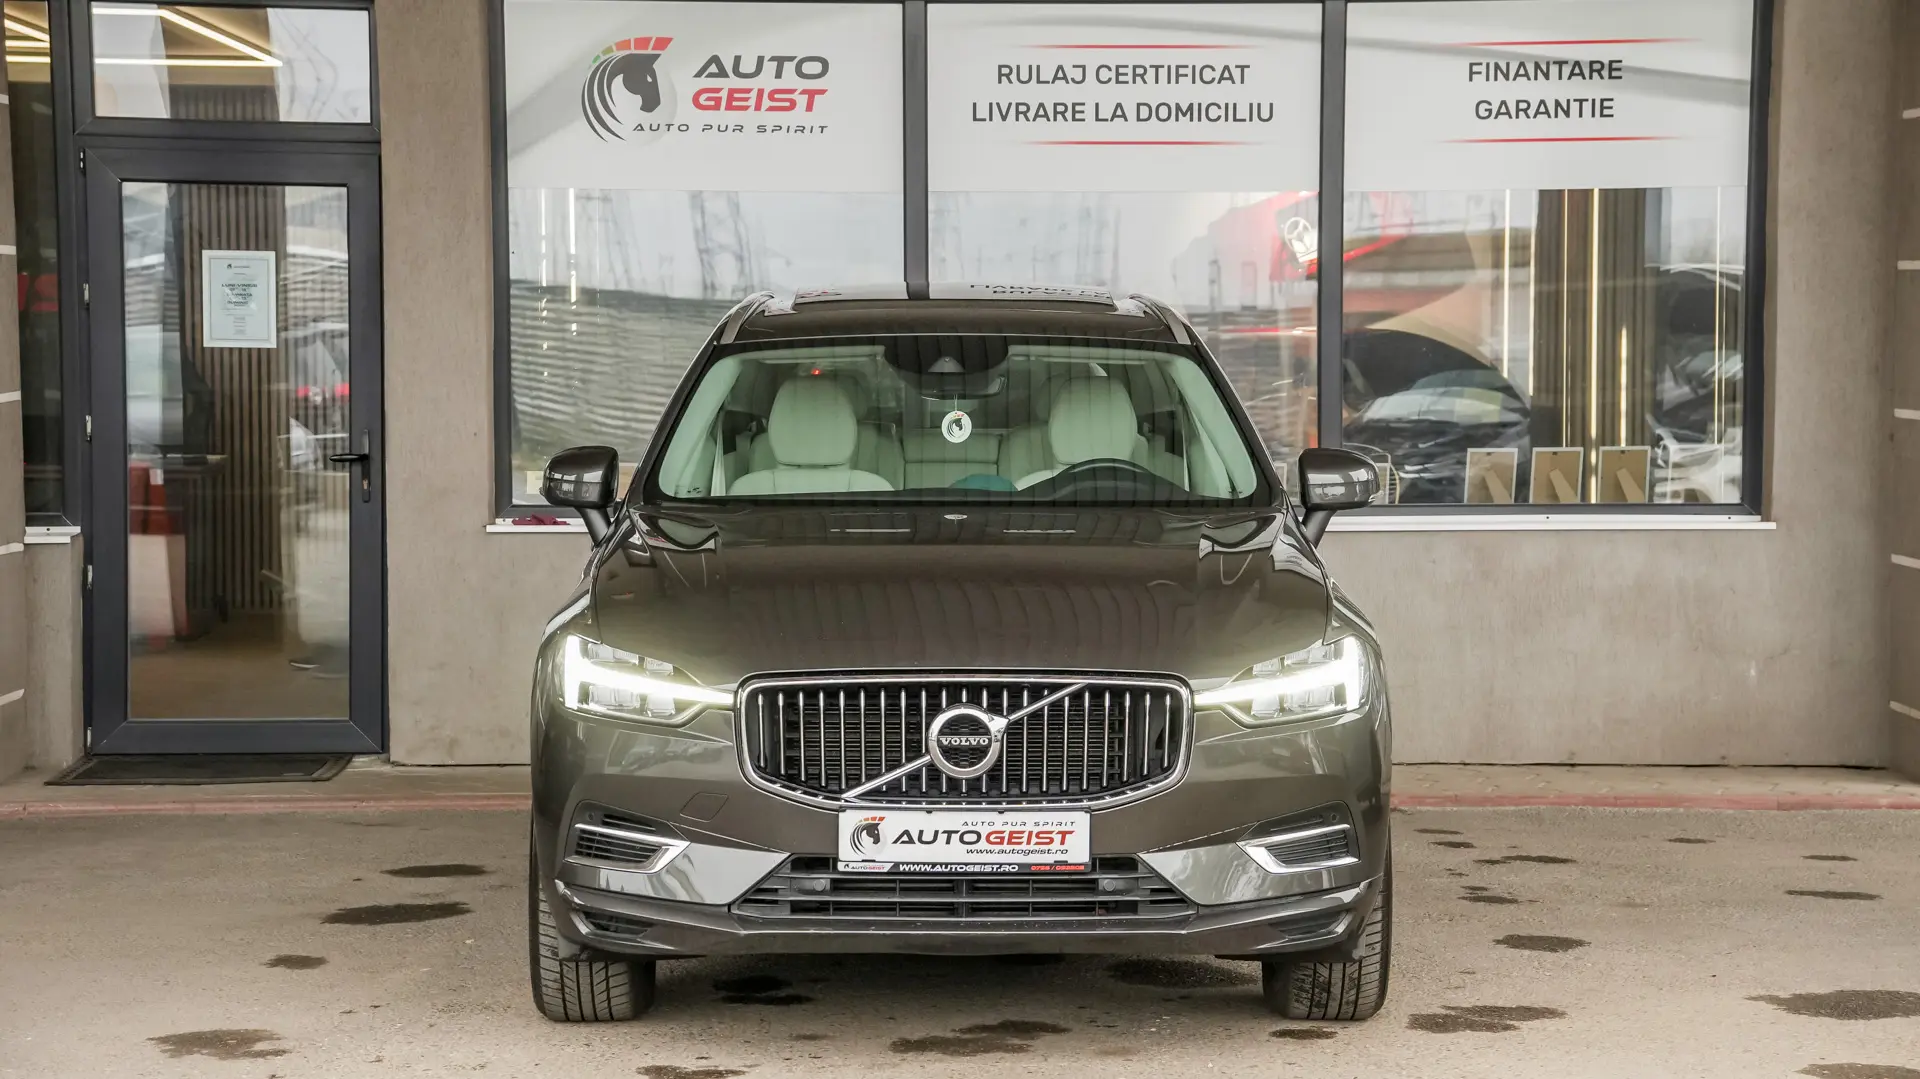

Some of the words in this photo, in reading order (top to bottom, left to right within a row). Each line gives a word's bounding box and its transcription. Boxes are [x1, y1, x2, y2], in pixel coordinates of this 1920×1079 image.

[692, 55, 830, 80] AUTO
[997, 64, 1087, 85] RULAJ
[1095, 64, 1251, 85] CERTIFICAT
[1468, 59, 1623, 82] FINANTARE
[691, 87, 828, 113] GEIST
[1475, 97, 1614, 120] GARANTIE
[972, 101, 1086, 123] LIVRARE
[1094, 102, 1129, 123] LA
[1136, 102, 1274, 123] DOMICILIU
[632, 123, 690, 134] AUTO
[701, 123, 744, 134] PUR
[756, 123, 829, 134] SPIRIT
[939, 737, 989, 746] VOLVO
[966, 847, 1069, 857] www.autogeist.ro
[899, 864, 1019, 873] WWW.AUTOGEIST.RO
